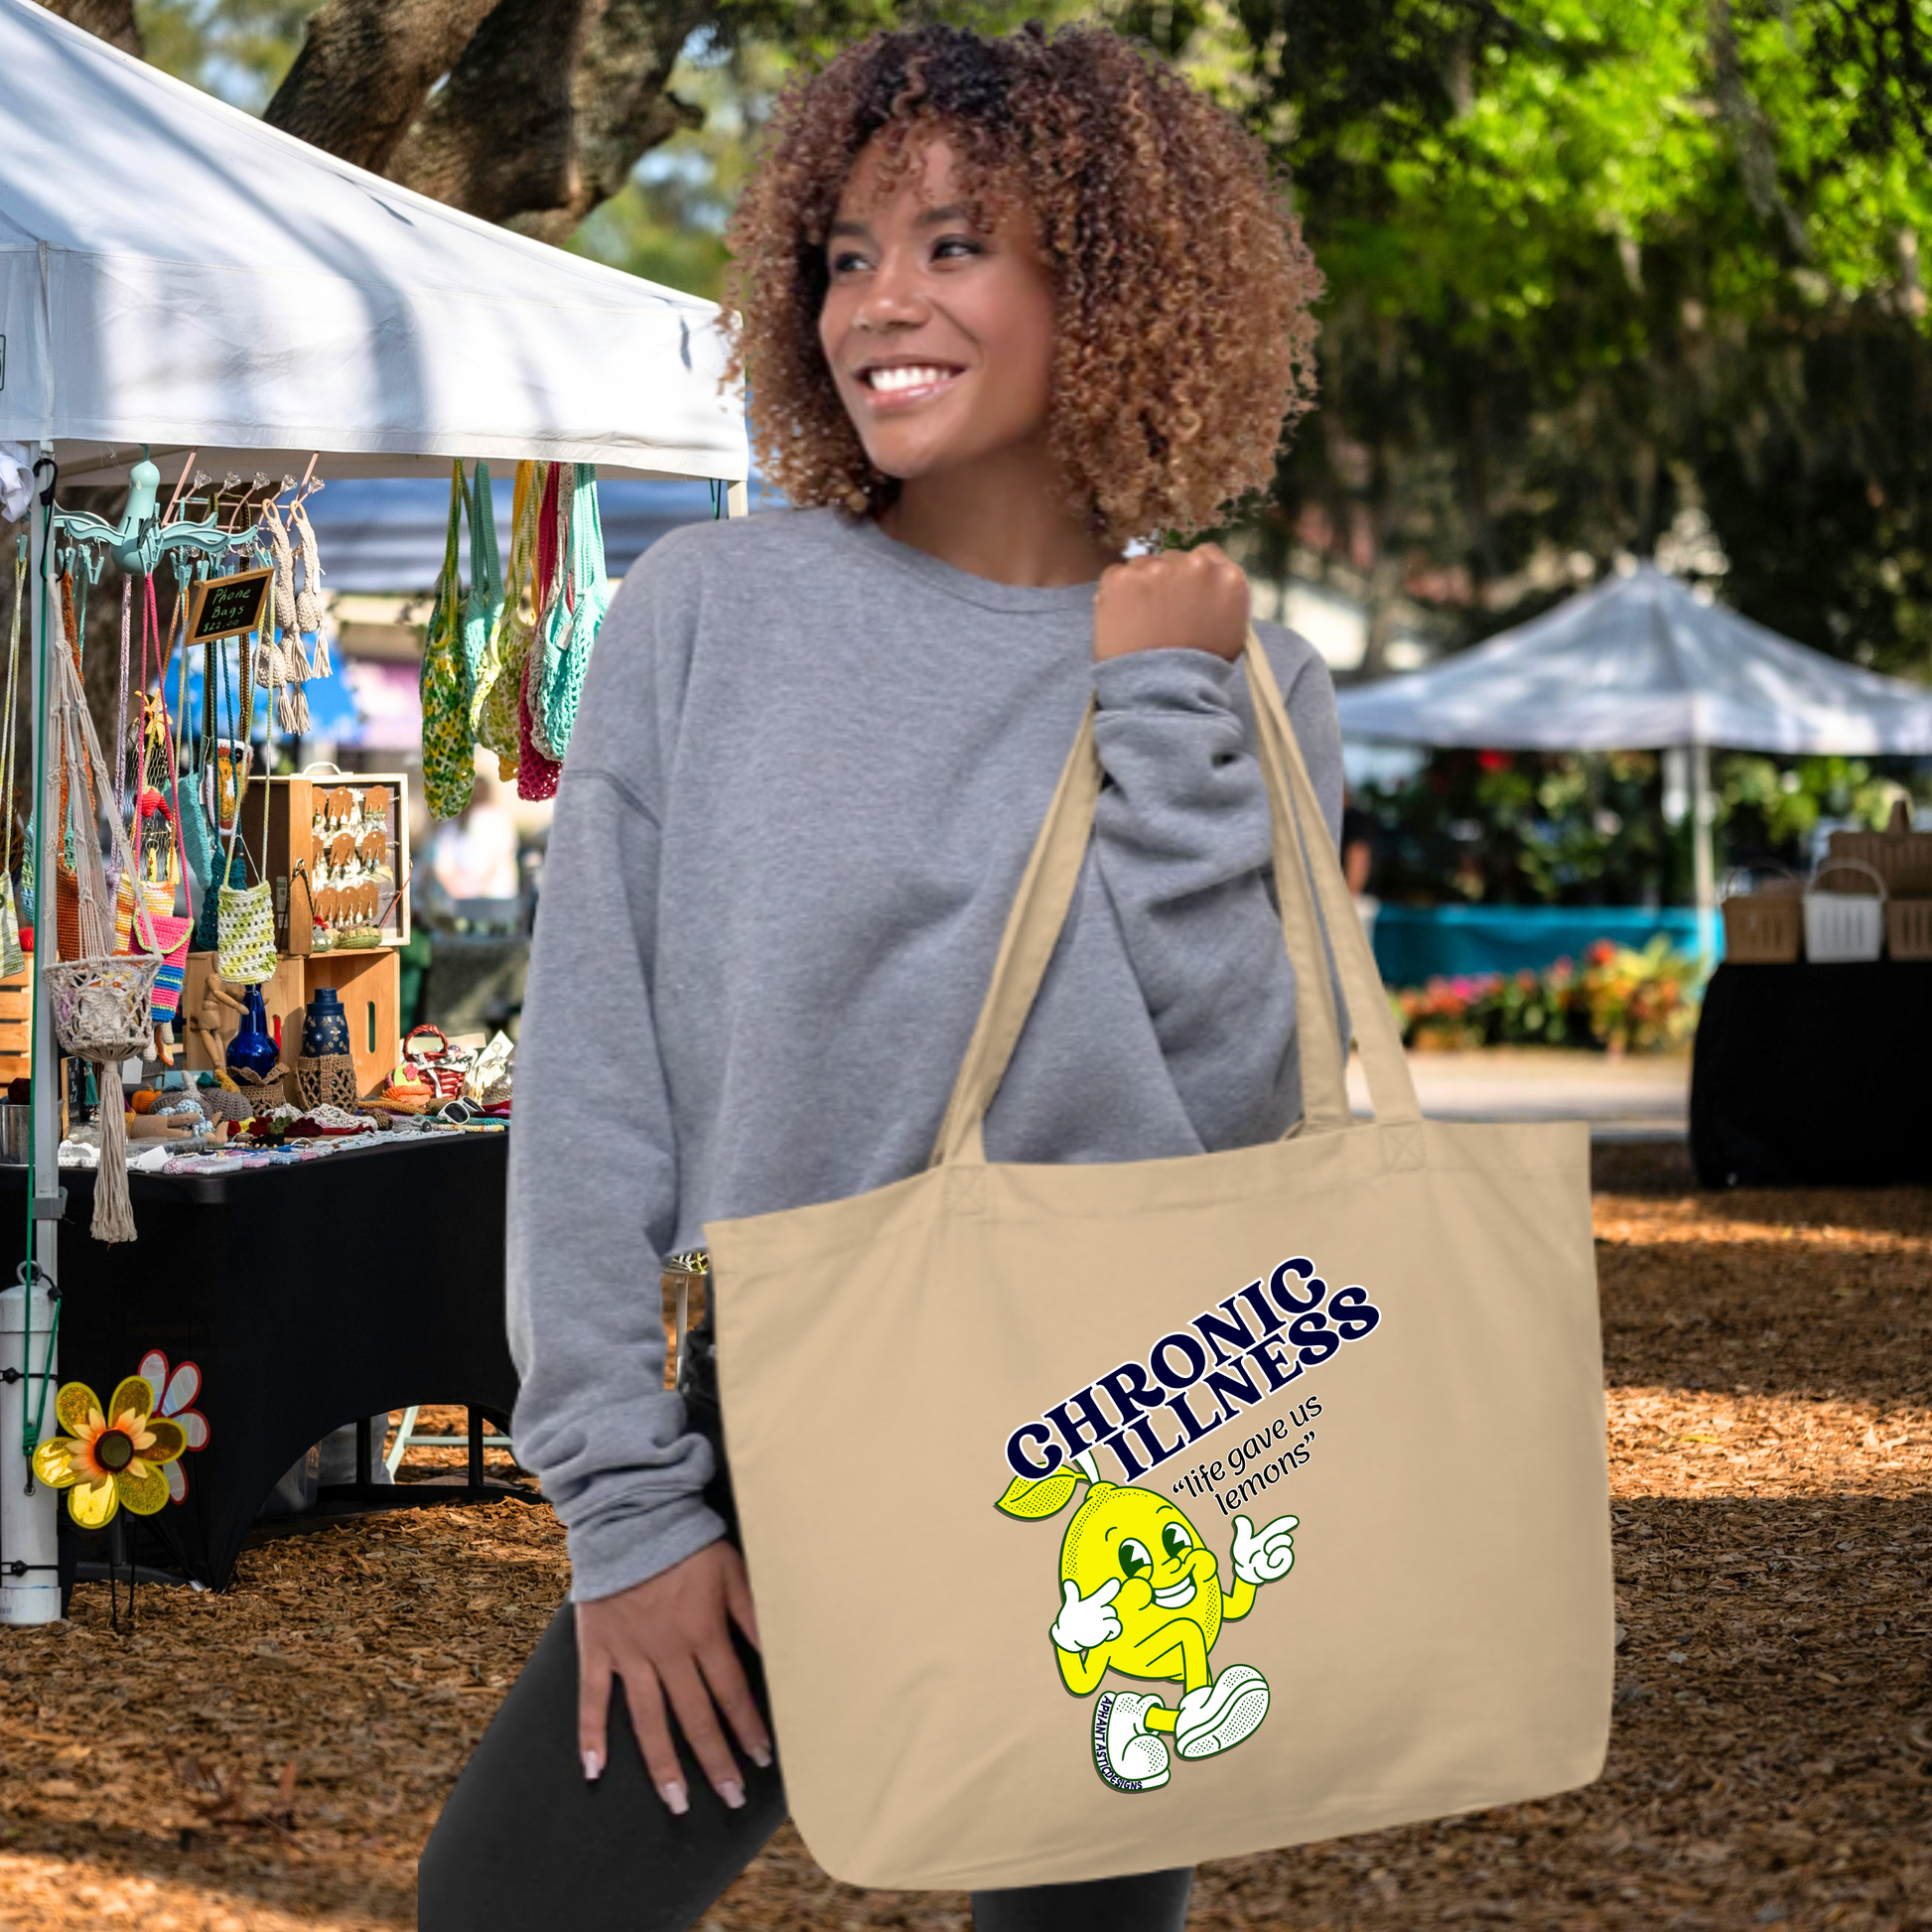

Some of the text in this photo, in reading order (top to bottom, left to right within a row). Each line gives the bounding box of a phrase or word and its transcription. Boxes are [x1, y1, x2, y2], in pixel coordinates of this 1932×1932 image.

[203, 620, 239, 632] $22.00
[210, 606, 244, 619] Bags
[211, 588, 251, 605] Phone
[1006, 1257, 1326, 1480] CHRONIC
[1103, 1287, 1380, 1484] ILLNESS
[1172, 1395, 1323, 1497] “life gave us
[1214, 1430, 1316, 1516] lemons”
